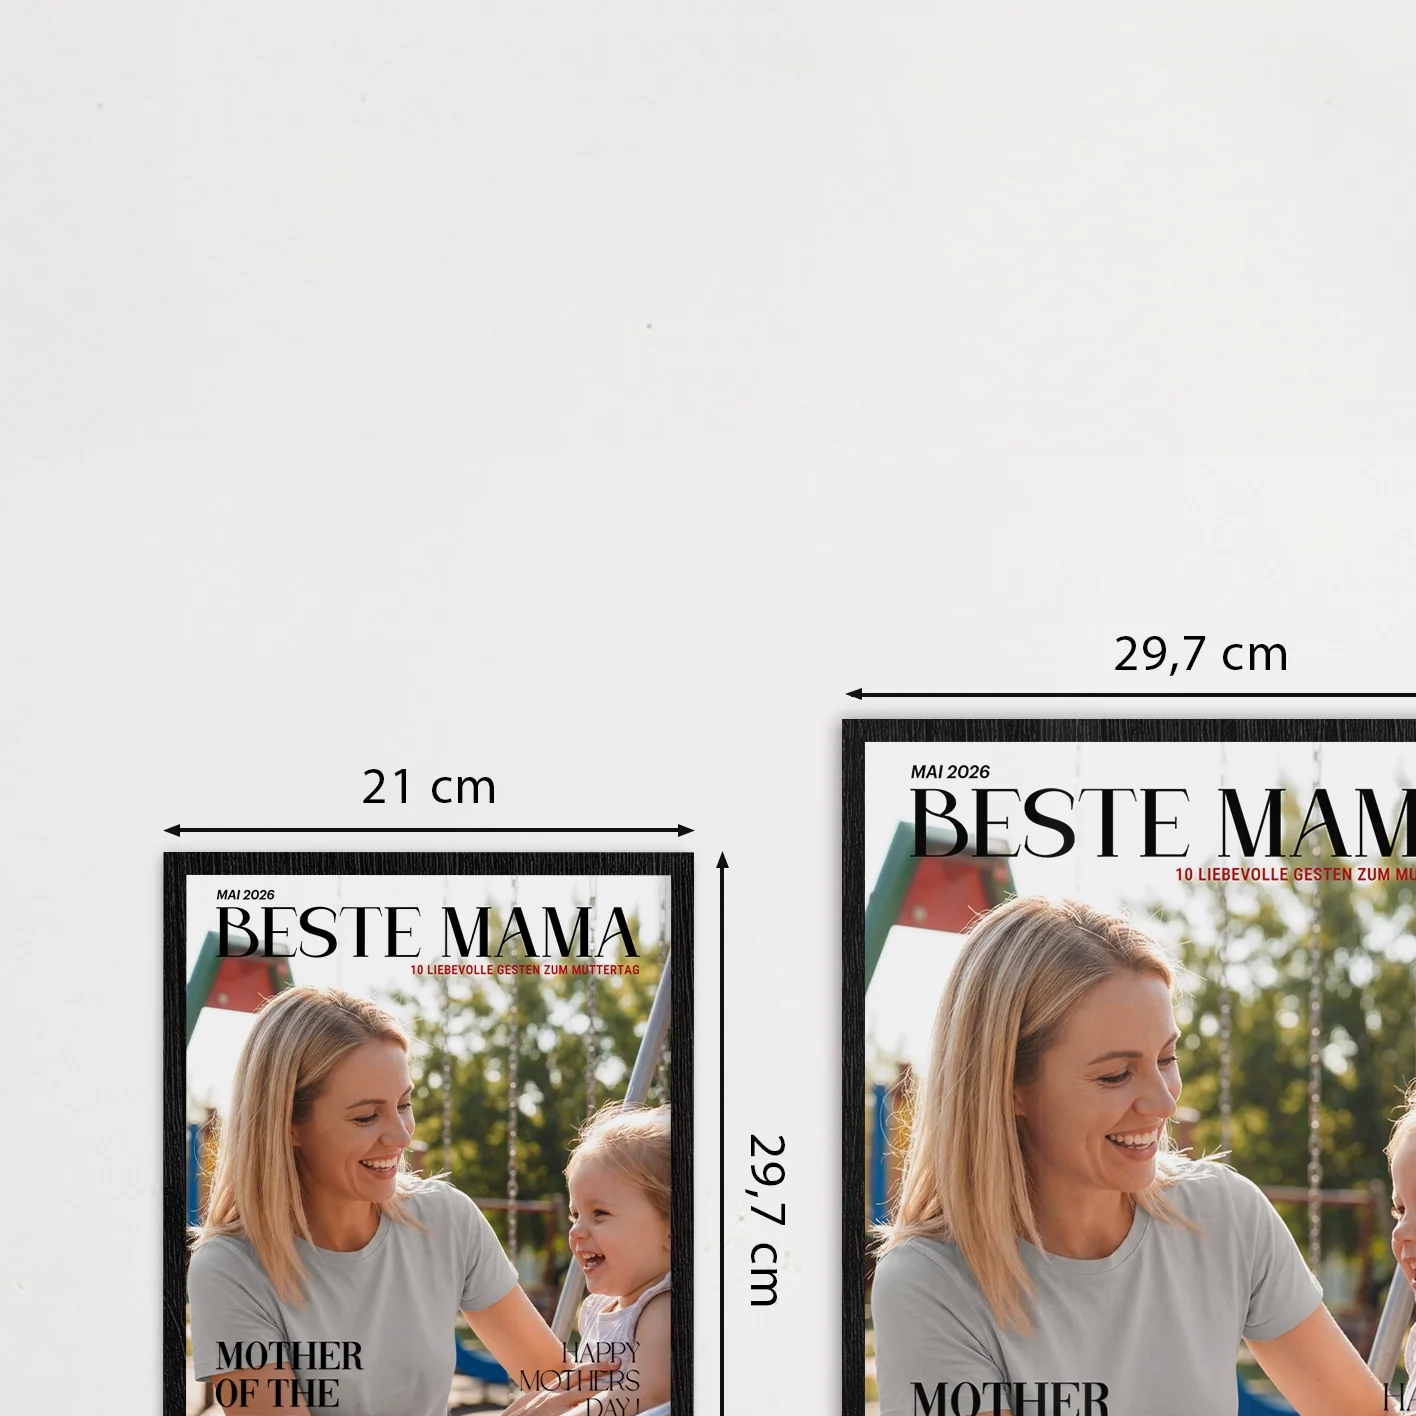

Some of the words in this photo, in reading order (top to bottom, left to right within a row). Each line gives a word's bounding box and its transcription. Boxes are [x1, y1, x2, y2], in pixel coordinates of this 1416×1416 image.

[911, 765, 943, 779] MAI
[946, 765, 990, 779] 2026
[910, 787, 1190, 858] BESTE
[1175, 867, 1193, 881] 10
[1199, 867, 1288, 881] LIEBEVOLLE
[1293, 867, 1352, 881] GESTEN
[1357, 867, 1391, 881] ZUM
[216, 889, 241, 900] MAI
[242, 889, 275, 900] 2026
[215, 906, 422, 958] BESTE
[441, 906, 641, 958] MAMA
[410, 964, 424, 975] 10
[427, 964, 493, 975] LIEBEVOLLE
[497, 964, 540, 975] GESTEN
[543, 964, 568, 975] ZUM
[571, 964, 640, 975] MUTTERTAG
[215, 1341, 365, 1370] MOTHER
[562, 1341, 641, 1363] HAPPY
[520, 1369, 641, 1392] MOTHERS
[215, 1378, 259, 1408] OF
[267, 1378, 339, 1408] THE
